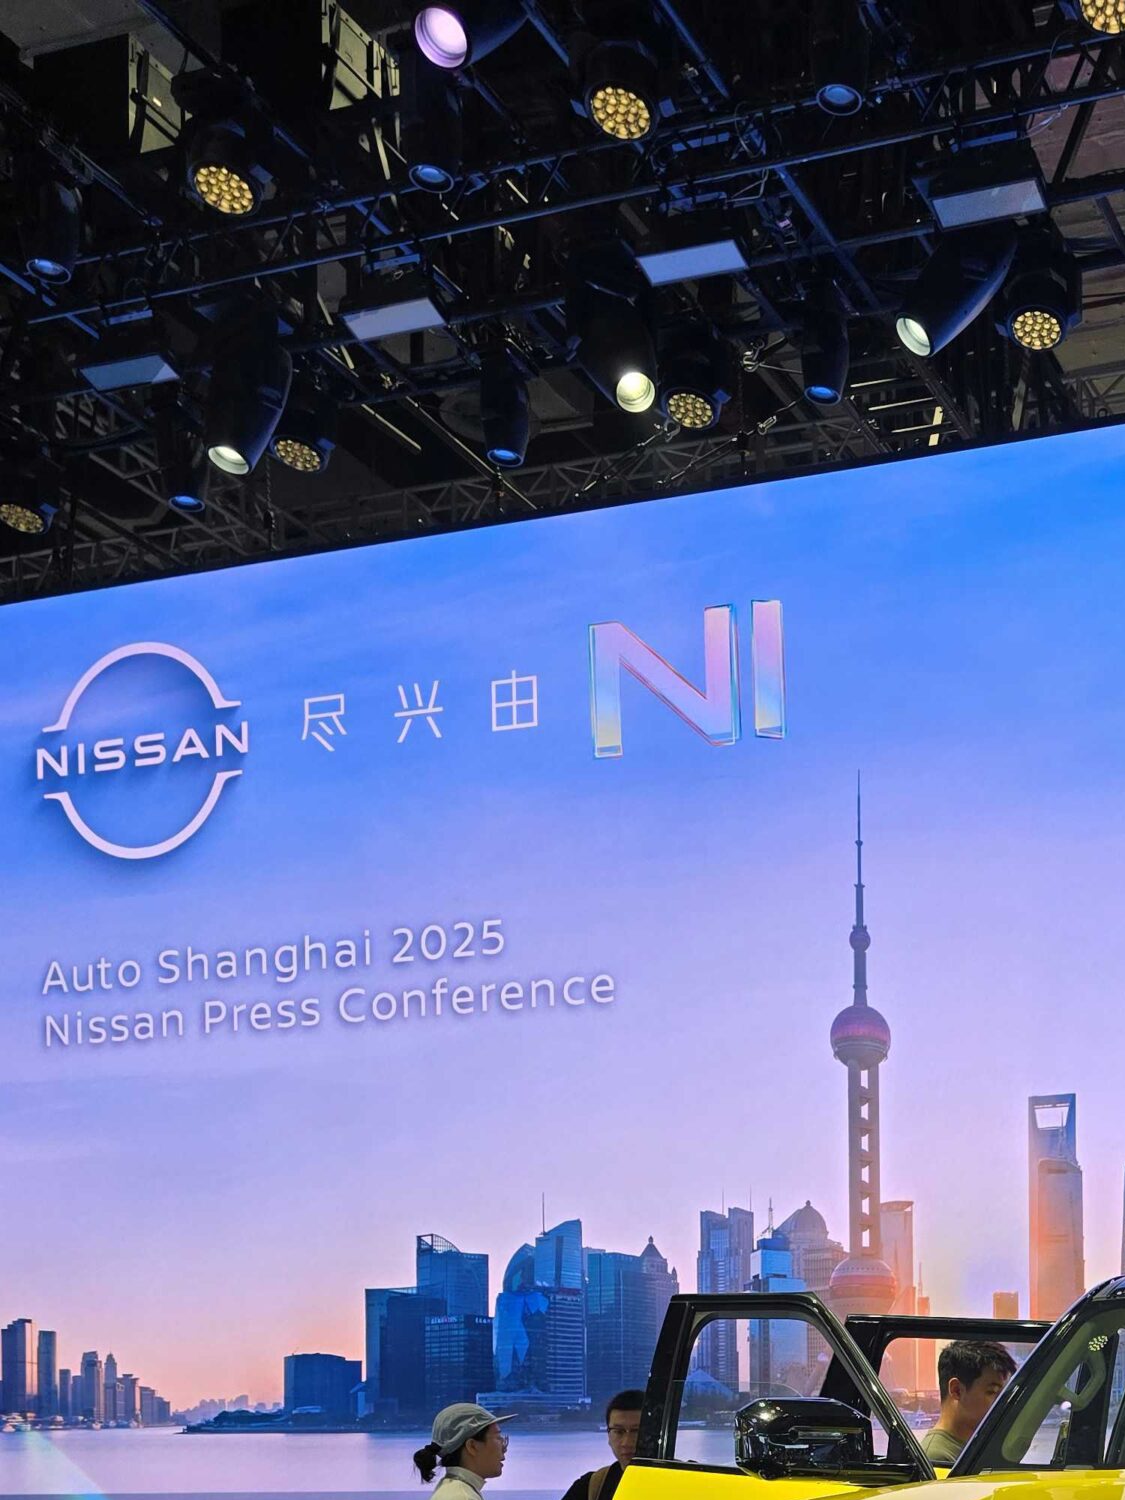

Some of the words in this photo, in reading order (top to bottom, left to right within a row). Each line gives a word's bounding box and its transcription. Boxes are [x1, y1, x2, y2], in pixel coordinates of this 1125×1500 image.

[588, 599, 787, 760] NI
[36, 721, 249, 780] NISSAN
[42, 957, 141, 995] Auto
[158, 929, 371, 984] Shanghai
[392, 919, 505, 963] 2025
[46, 1008, 184, 1047] Nissan
[204, 997, 320, 1034] Press
[339, 973, 615, 1023] Conference
